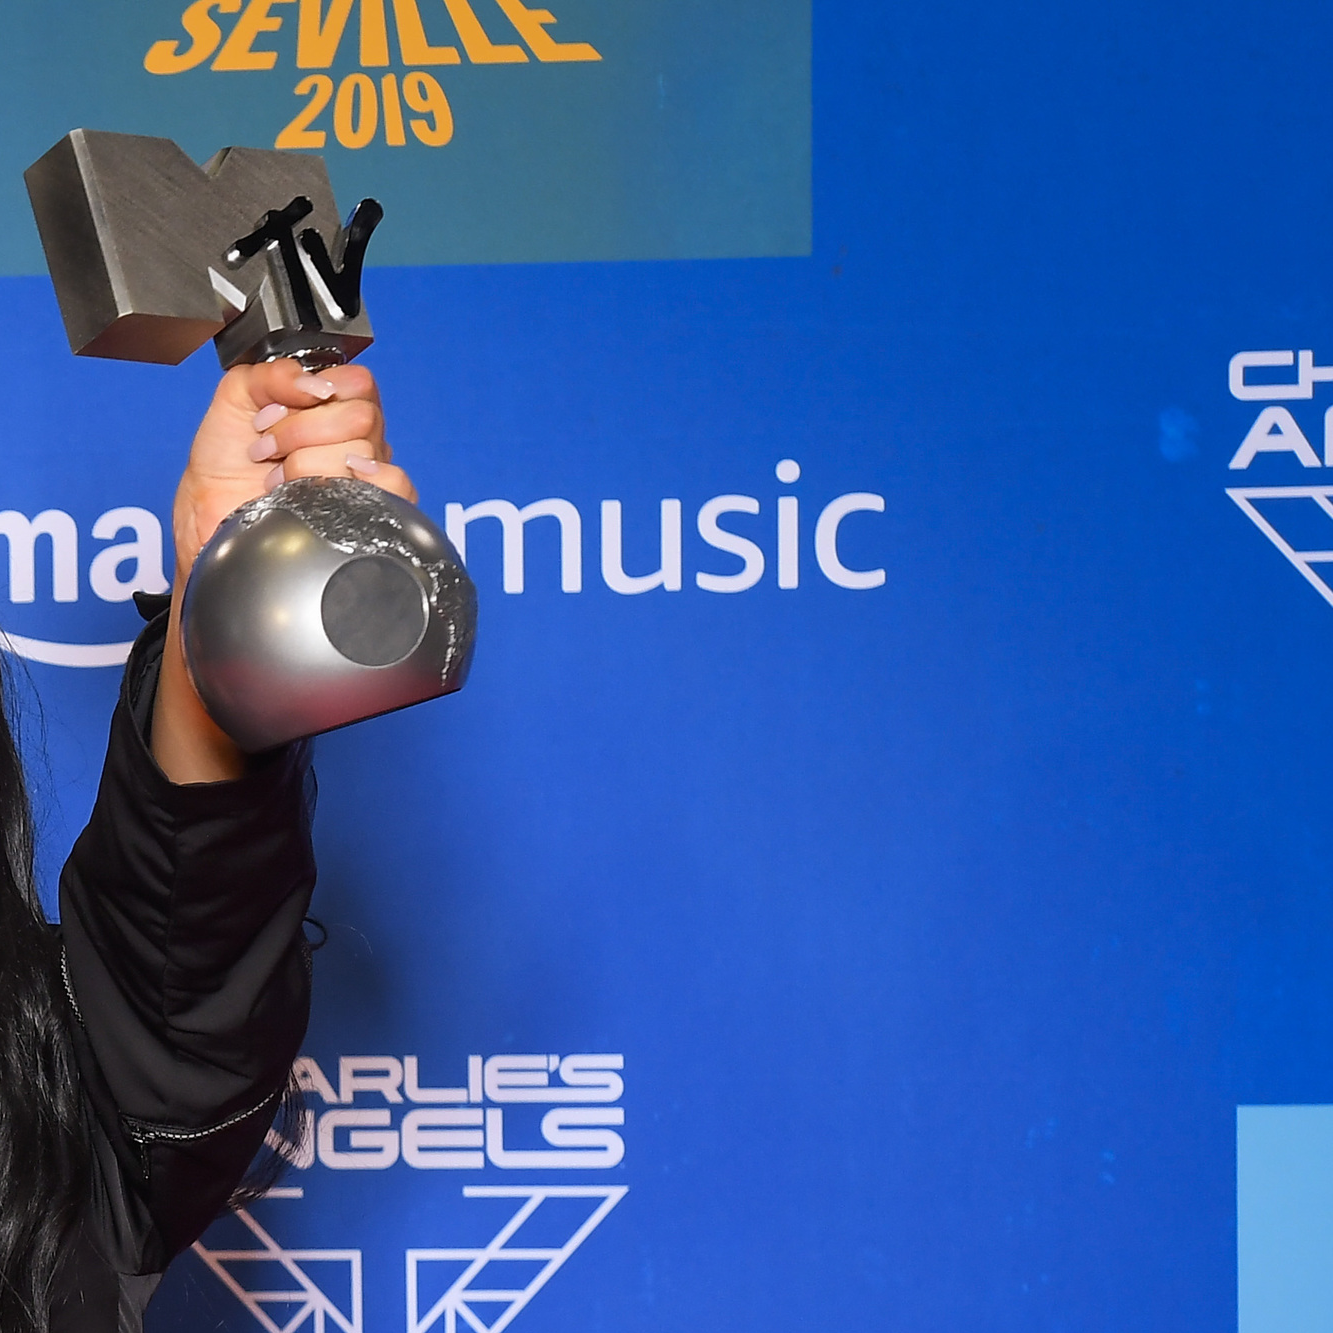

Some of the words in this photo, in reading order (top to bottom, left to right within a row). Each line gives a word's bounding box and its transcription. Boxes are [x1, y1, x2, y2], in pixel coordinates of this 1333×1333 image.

[143, 0, 603, 75] SEVILLE
[275, 71, 454, 149] 2019
[445, 459, 886, 595] music
[281, 1054, 625, 1103] ARLIE'S
[264, 1107, 625, 1170] NGELS
